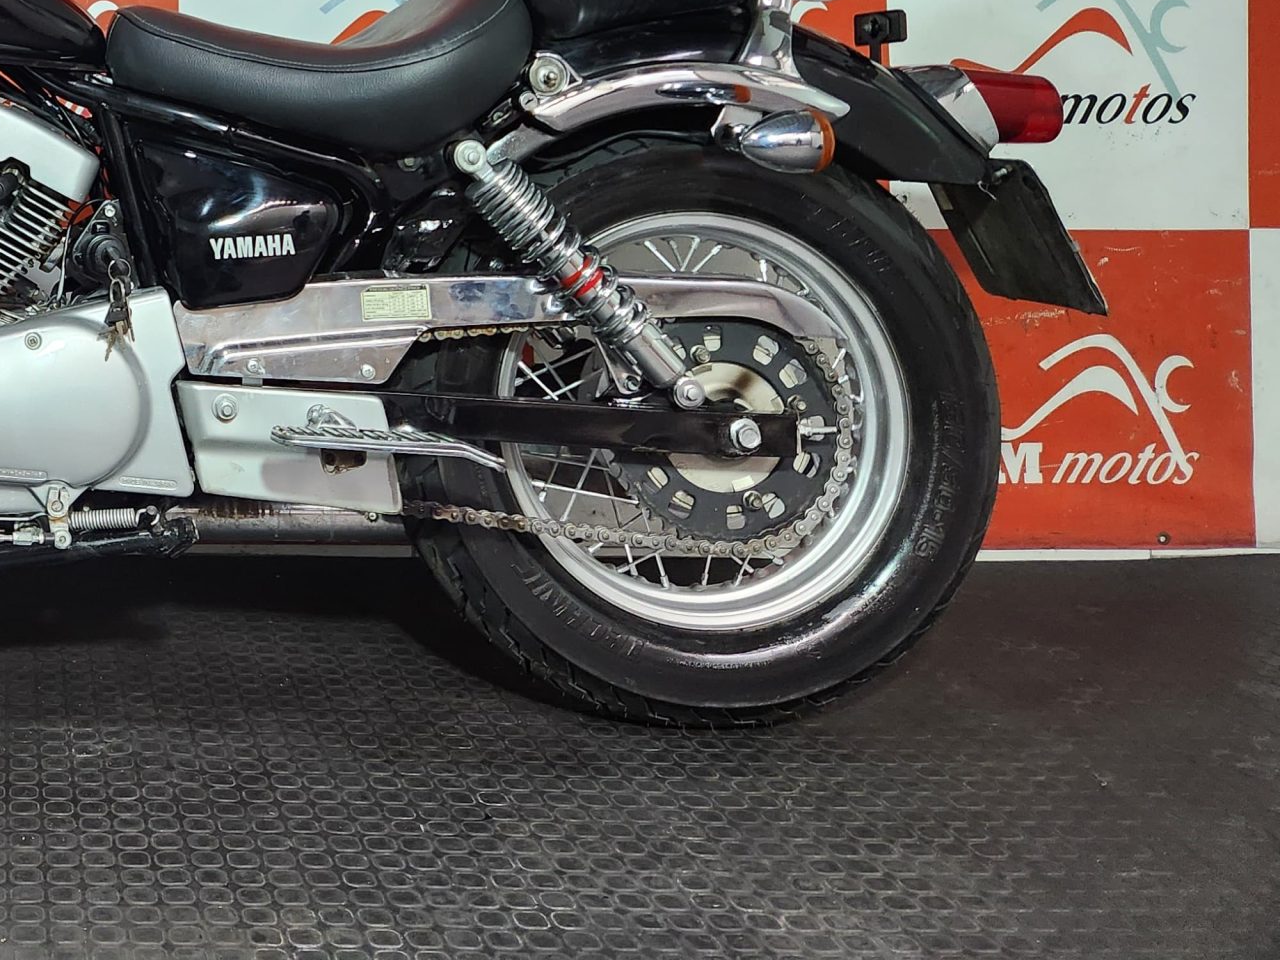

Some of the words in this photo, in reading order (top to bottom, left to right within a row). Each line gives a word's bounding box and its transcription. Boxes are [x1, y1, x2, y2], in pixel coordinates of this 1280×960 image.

[1061, 83, 1196, 124] motos
[210, 234, 295, 260] YAMAHA
[1052, 443, 1200, 485] motos
